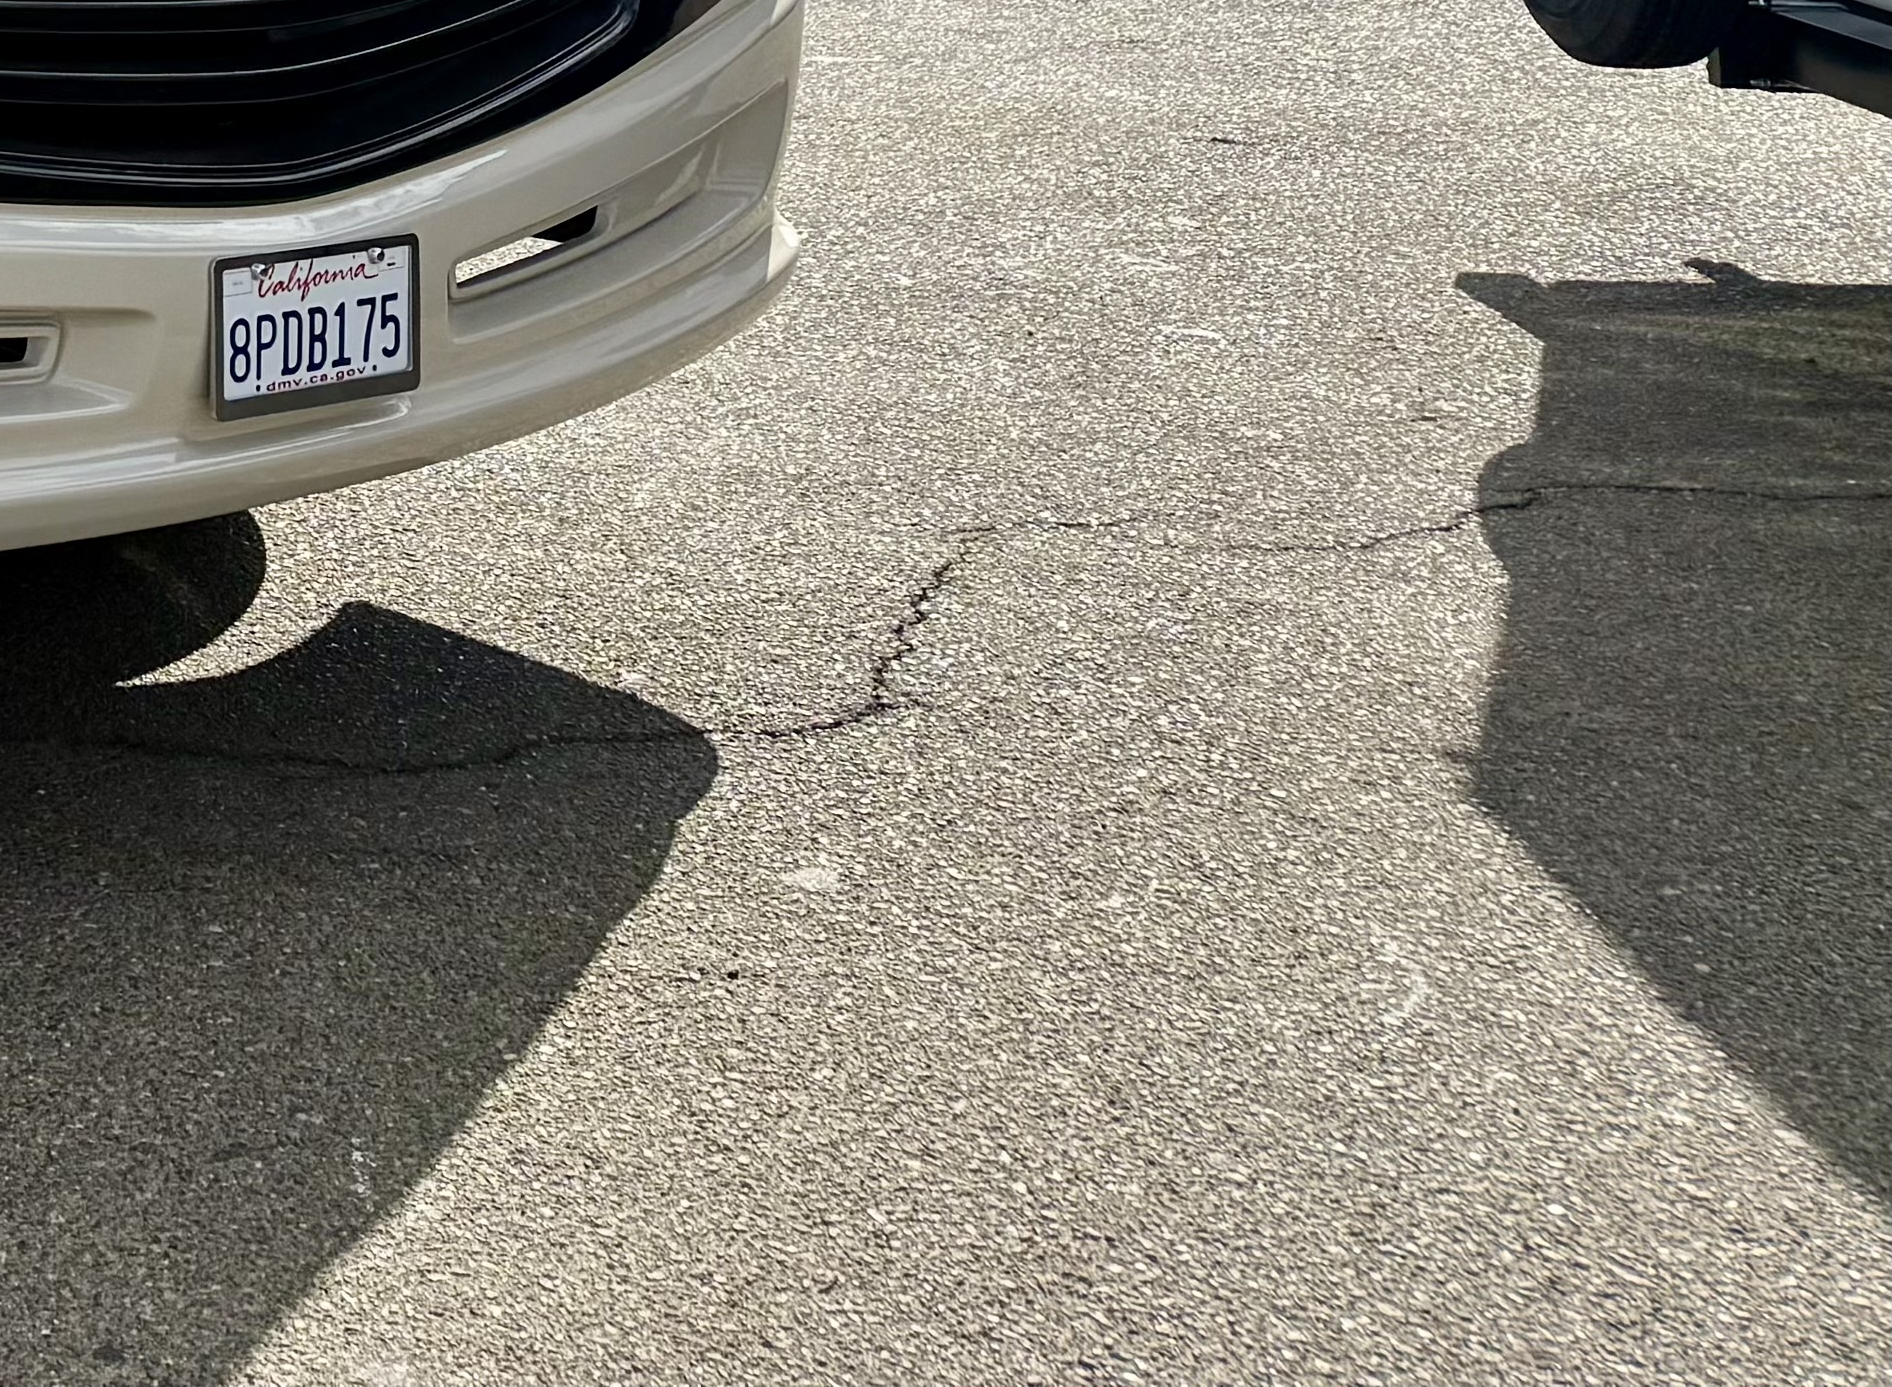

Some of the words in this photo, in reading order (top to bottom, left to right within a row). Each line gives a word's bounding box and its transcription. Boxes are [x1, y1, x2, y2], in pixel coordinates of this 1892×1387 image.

[257, 259, 378, 302] California
[229, 292, 401, 384] 8PDB175
[266, 365, 367, 393] dmv.ca.gov
